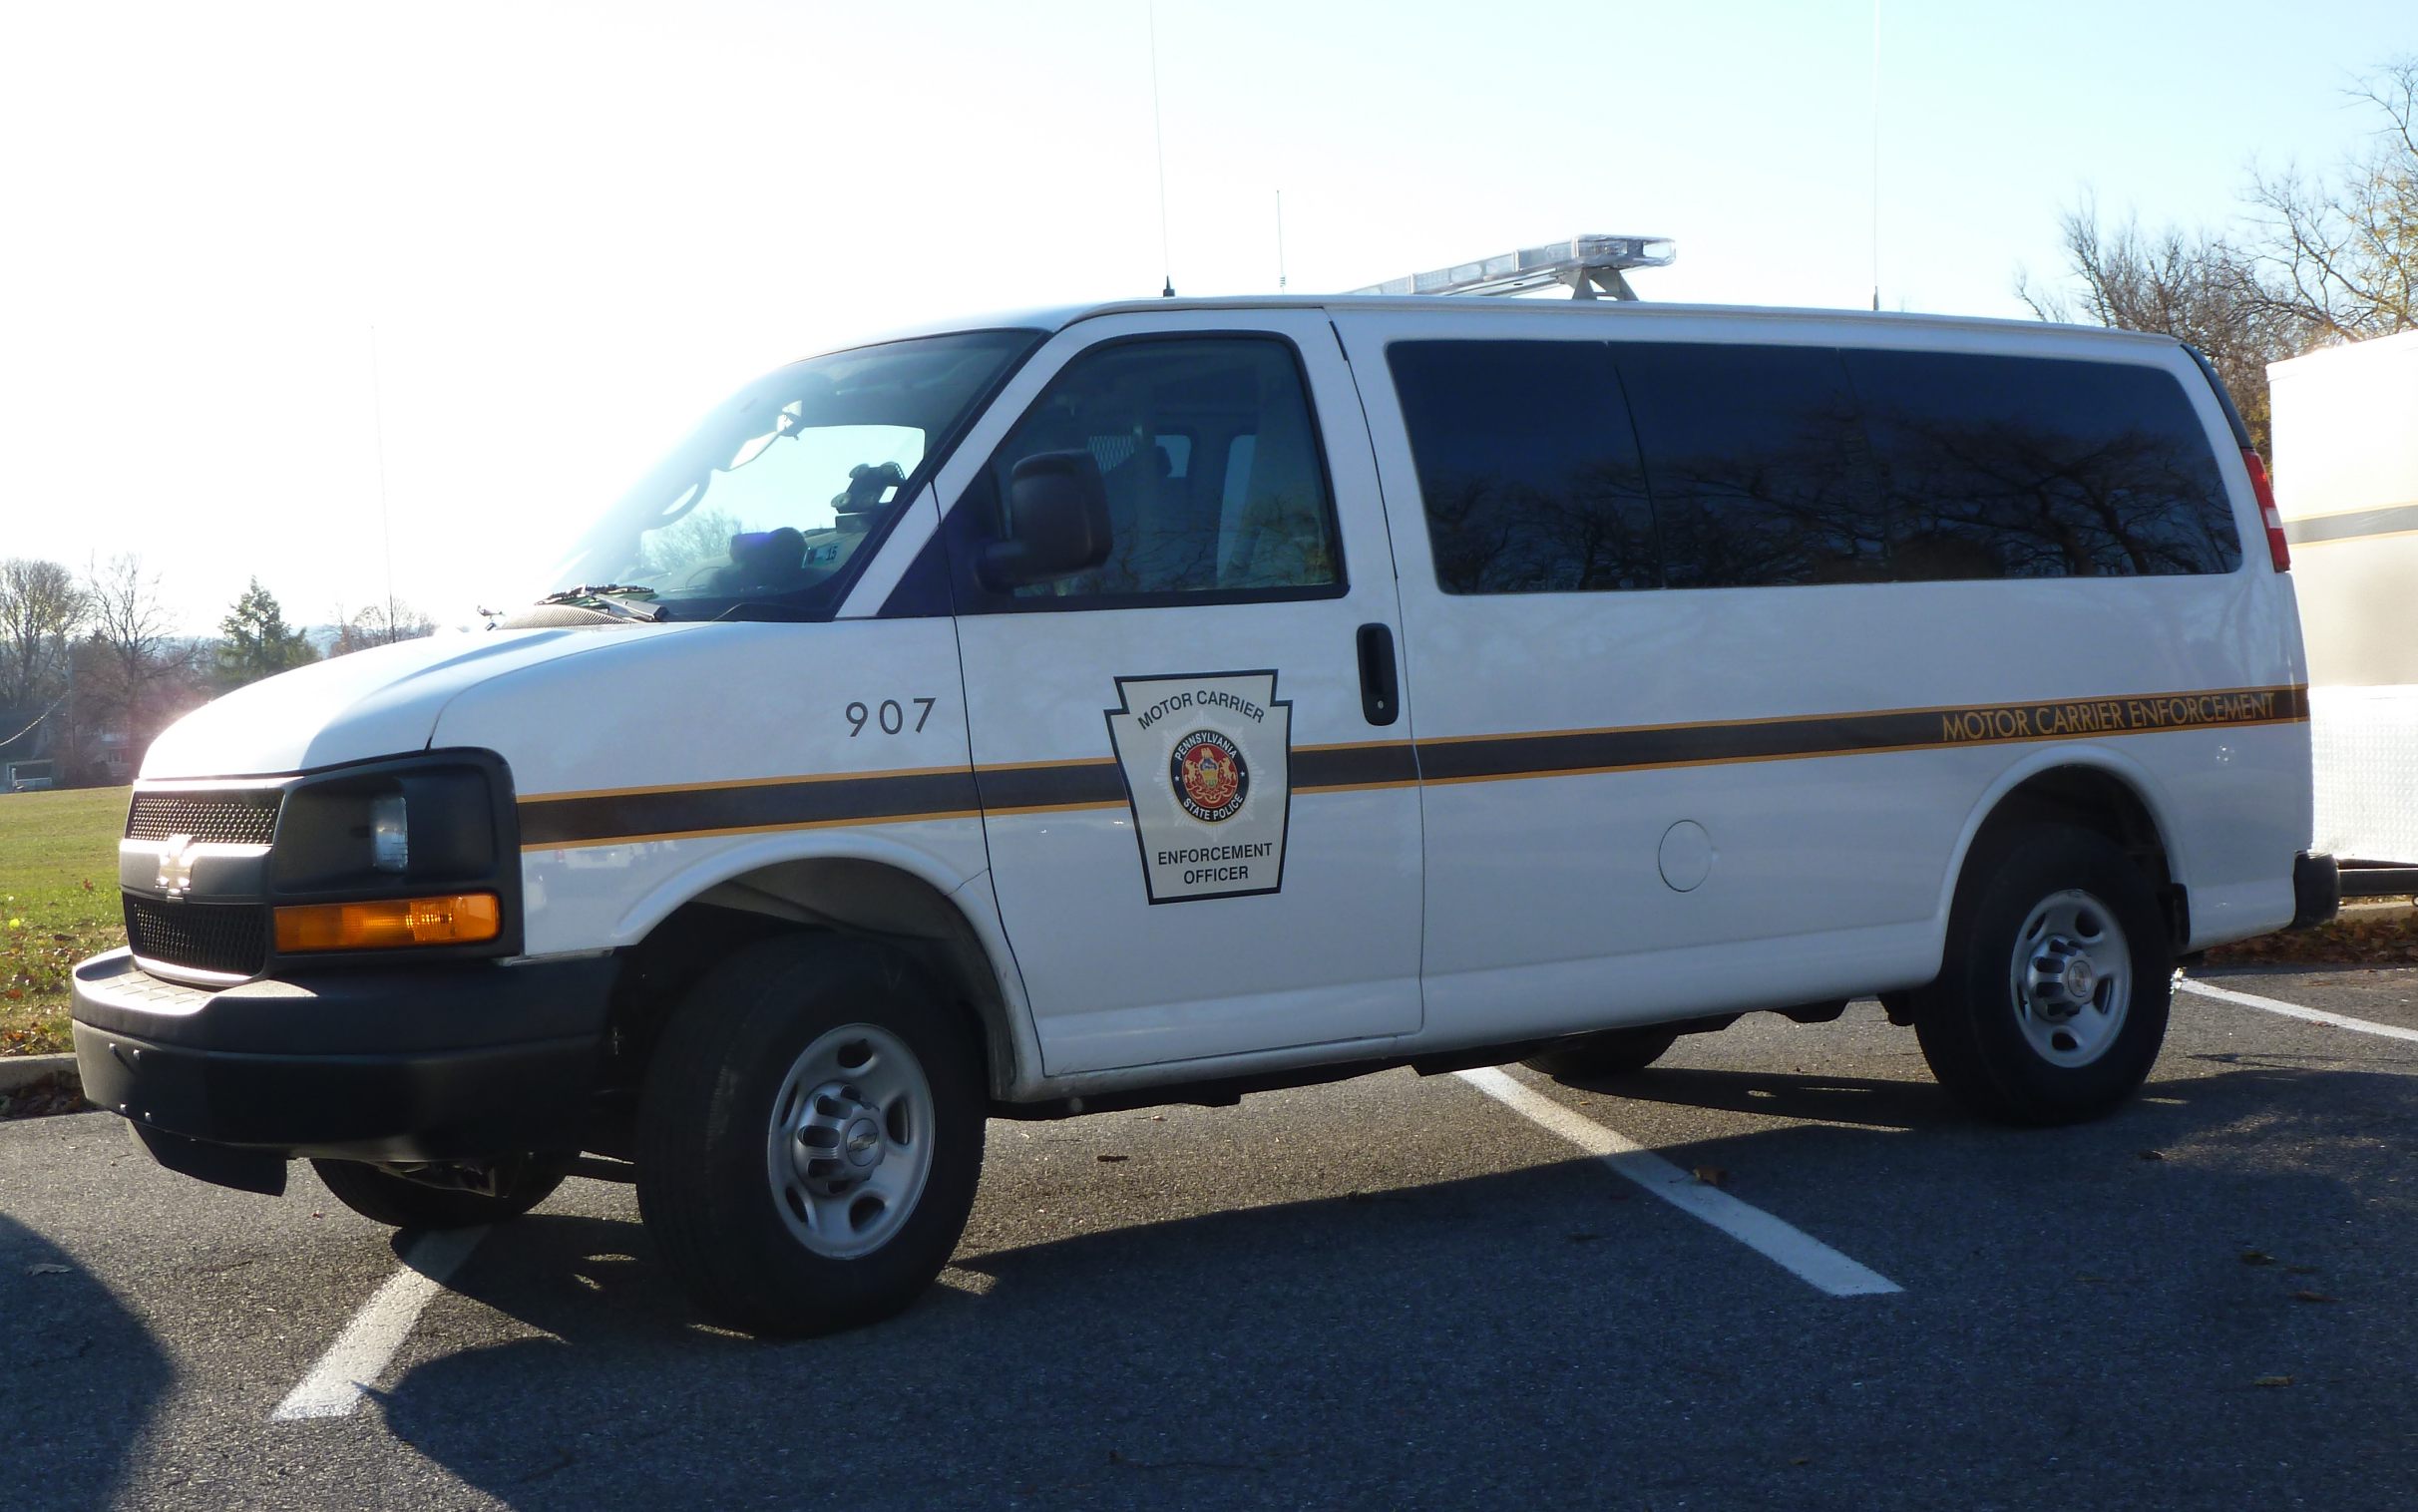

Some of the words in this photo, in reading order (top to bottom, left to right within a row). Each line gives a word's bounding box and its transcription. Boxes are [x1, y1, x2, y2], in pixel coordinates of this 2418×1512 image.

[845, 697, 937, 737] 907
[1137, 692, 1193, 730] MOTOR
[1196, 690, 1266, 724] CARRIER
[1942, 709, 2032, 741] MOTOR
[2035, 701, 2127, 735] CARRIER
[2129, 692, 2275, 727] ENFORCEMENT
[1174, 731, 1238, 761] PENNSYLVANIA
[1183, 797, 1211, 821] STATE
[1213, 794, 1244, 821] POLICE
[1157, 843, 1274, 865] ENFORCEMENT
[1183, 866, 1249, 885] OFFICER
